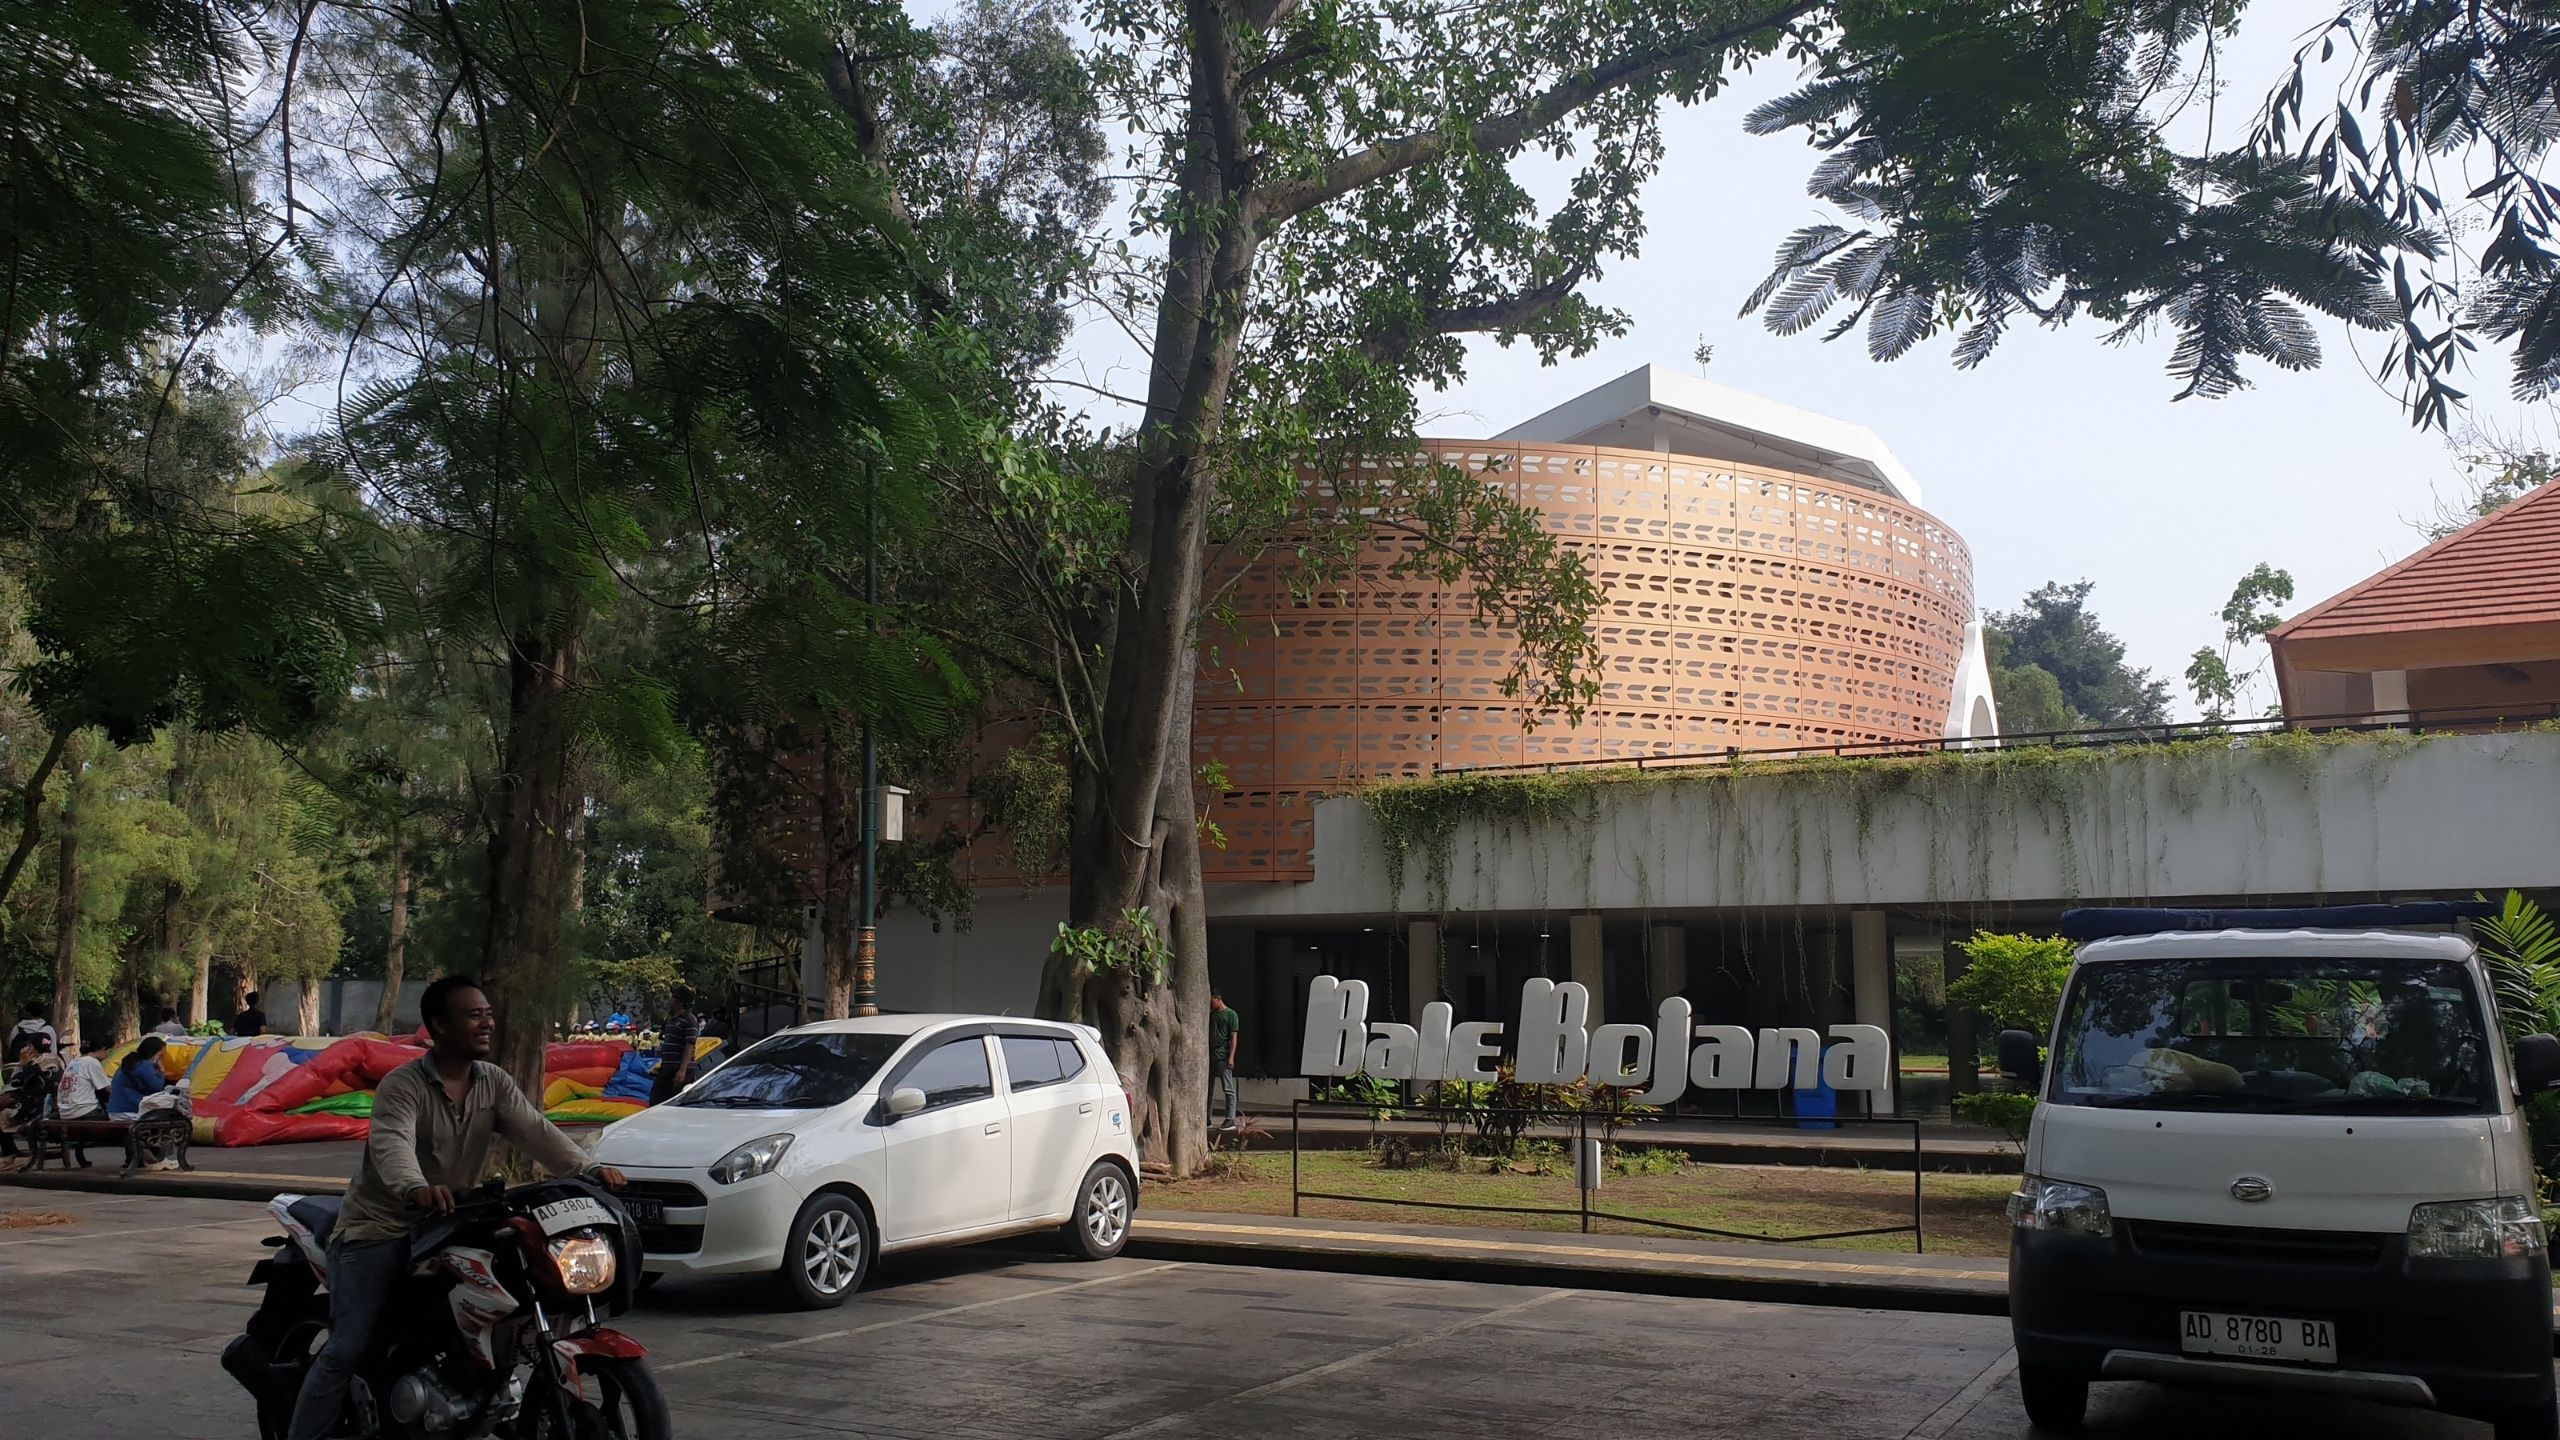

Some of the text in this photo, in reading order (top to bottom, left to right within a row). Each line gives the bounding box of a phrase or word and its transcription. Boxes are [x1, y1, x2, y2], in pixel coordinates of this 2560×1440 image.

[1514, 976, 1891, 1104] Bojana
[537, 1204, 558, 1221] AD
[2185, 1313, 2331, 1349] AD 8780 BA
